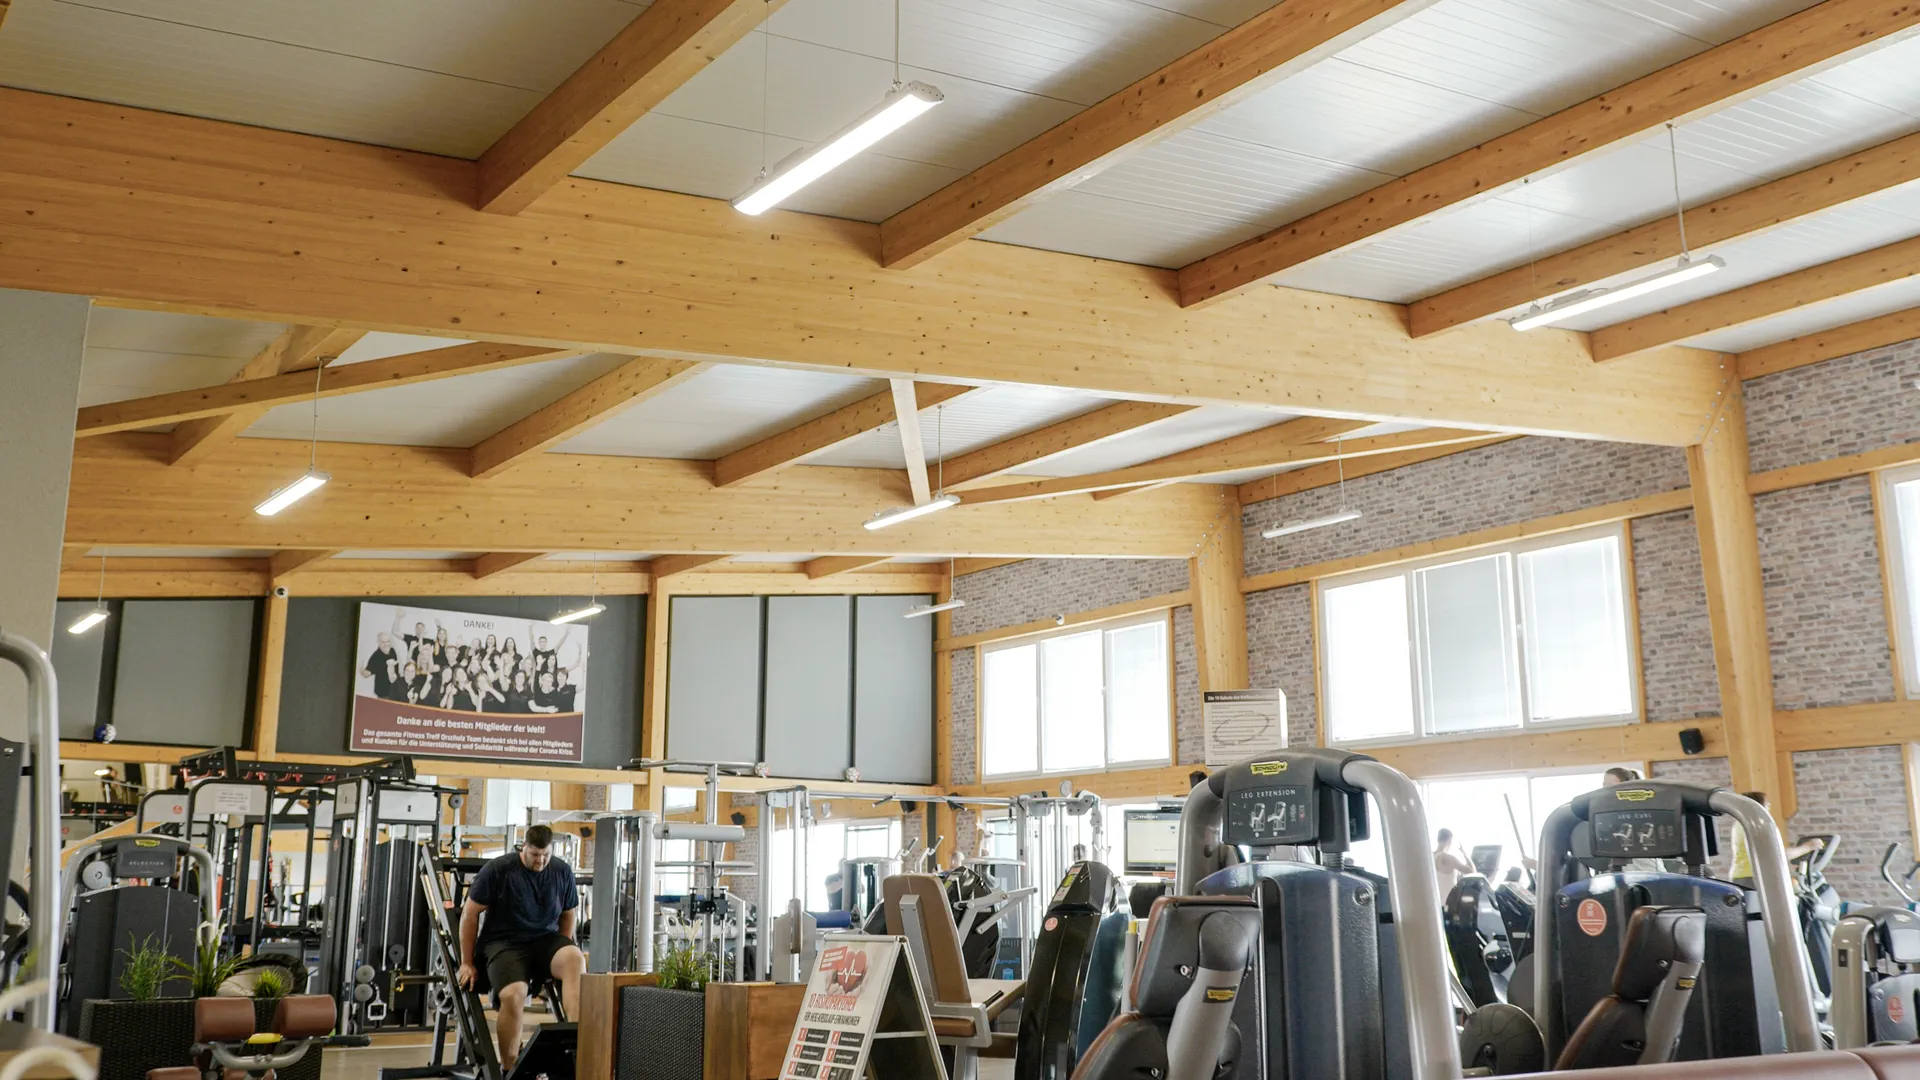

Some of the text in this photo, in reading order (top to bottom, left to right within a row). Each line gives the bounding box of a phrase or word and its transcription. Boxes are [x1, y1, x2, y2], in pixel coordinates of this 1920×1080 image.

[463, 619, 494, 630] DANKE!
[397, 716, 421, 726] Danke
[422, 719, 432, 727] an
[433, 718, 446, 727] die
[448, 720, 473, 729] besten
[474, 721, 512, 732] Mitglieder
[513, 724, 526, 733] der
[363, 728, 375, 736] Das
[375, 730, 402, 738] gesamte
[402, 731, 425, 739] Fitness
[425, 732, 440, 740] Treff
[482, 736, 506, 744] bedankt
[506, 737, 518, 745] sich
[528, 738, 542, 746] allen
[374, 738, 398, 746] Kunden
[398, 738, 408, 746] für
[503, 745, 528, 753] während
[538, 747, 558, 755] Corona
[1257, 789, 1296, 798] EXTENSION
